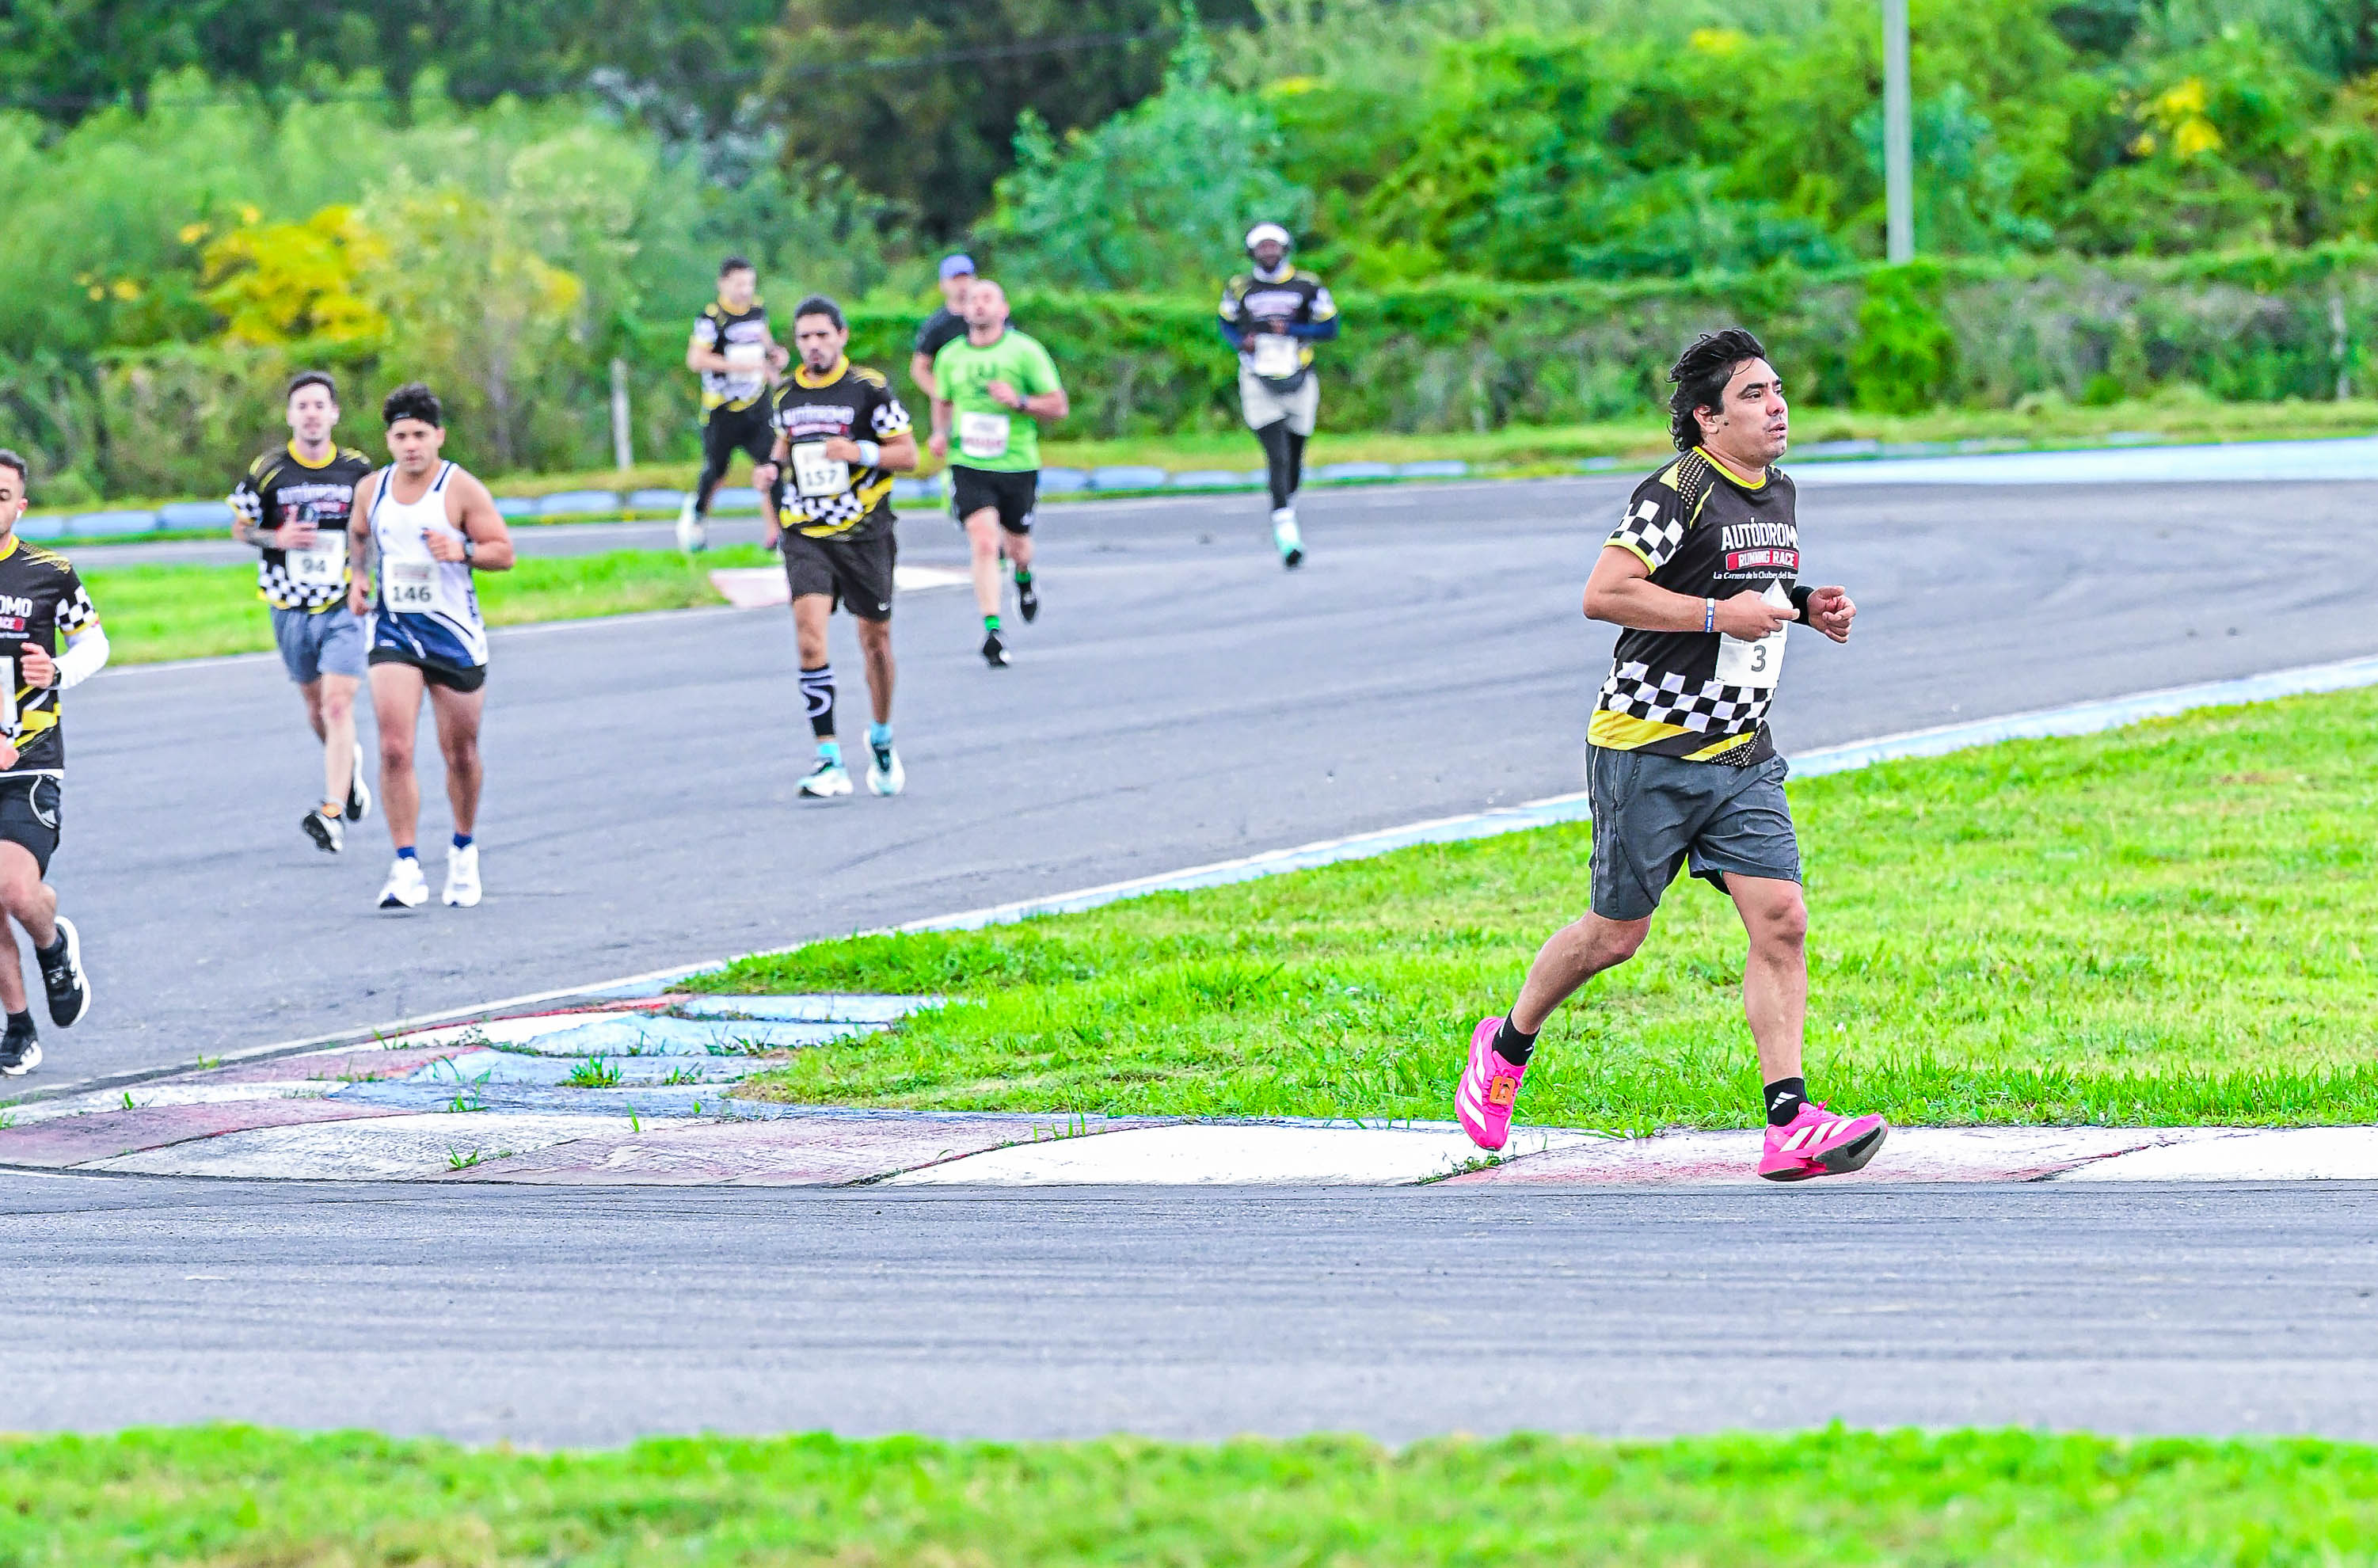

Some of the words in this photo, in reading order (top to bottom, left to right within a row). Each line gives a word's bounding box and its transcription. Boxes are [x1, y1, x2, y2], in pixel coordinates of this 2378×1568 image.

[805, 469, 837, 486] 157
[1721, 517, 1799, 551] AUTÓDROM
[302, 558, 325, 574] 94
[1738, 550, 1770, 567] RUNNING
[1773, 550, 1794, 566] RACE
[393, 586, 432, 603] 146
[1751, 645, 1767, 672] 3
